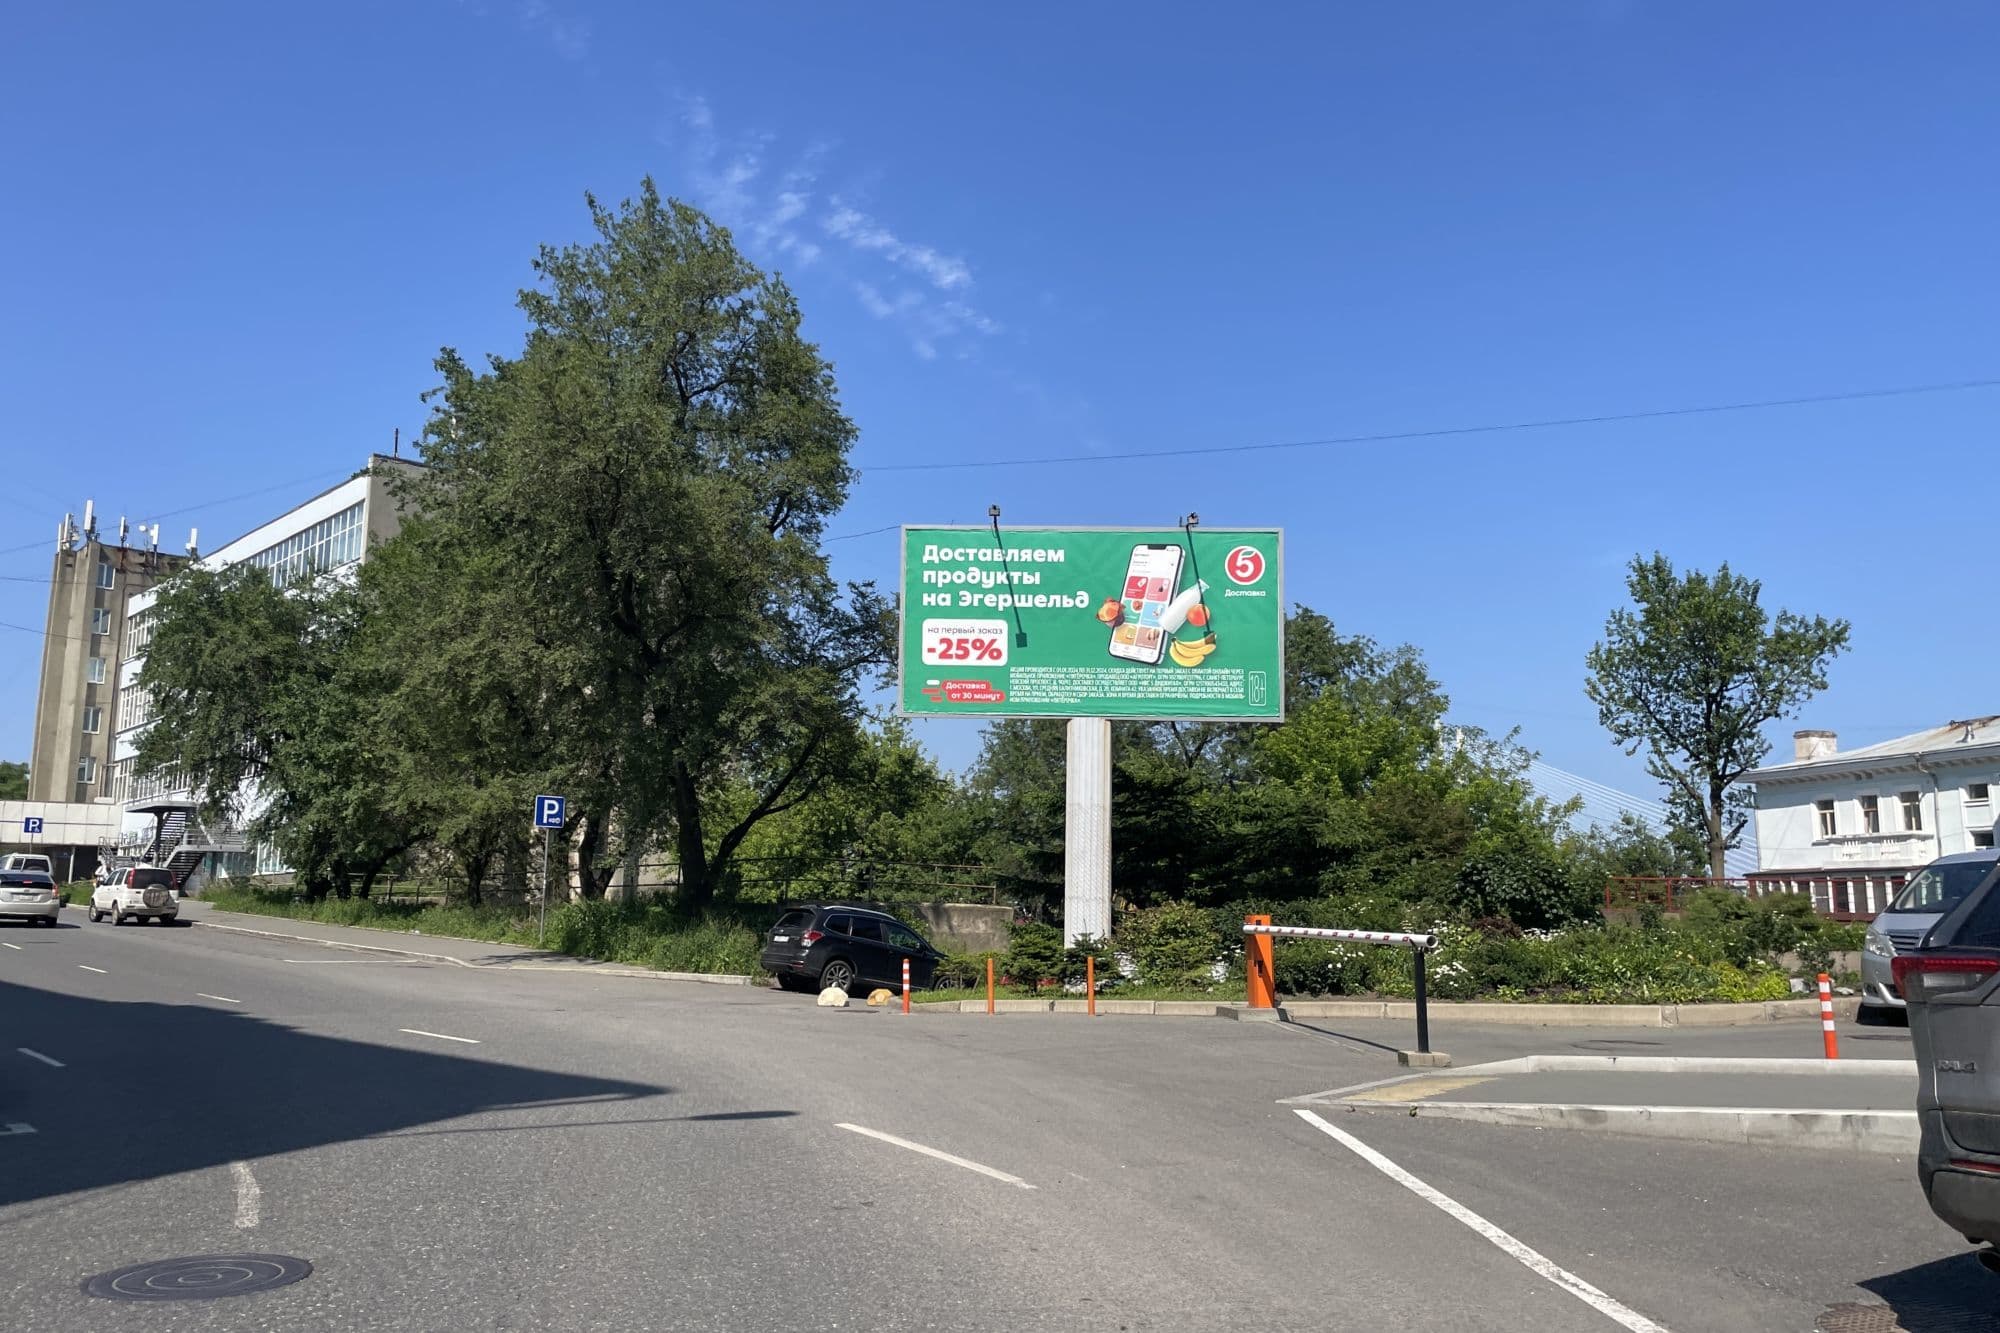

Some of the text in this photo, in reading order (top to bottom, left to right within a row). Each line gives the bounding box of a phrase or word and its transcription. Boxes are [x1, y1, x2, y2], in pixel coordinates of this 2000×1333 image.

[922, 544, 1065, 564] Доставляем
[922, 567, 1041, 589] продукты
[922, 590, 1090, 611] на Эгершельд
[1224, 589, 1266, 598] Доставка
[941, 626, 975, 637] первый
[978, 627, 1003, 635] заказ
[927, 638, 1003, 661] -25%
[945, 682, 987, 690] Доставка
[951, 692, 962, 700] от
[963, 691, 972, 700] 30
[973, 692, 1001, 701] минут
[1250, 674, 1265, 703] 18+
[543, 799, 560, 824] P
